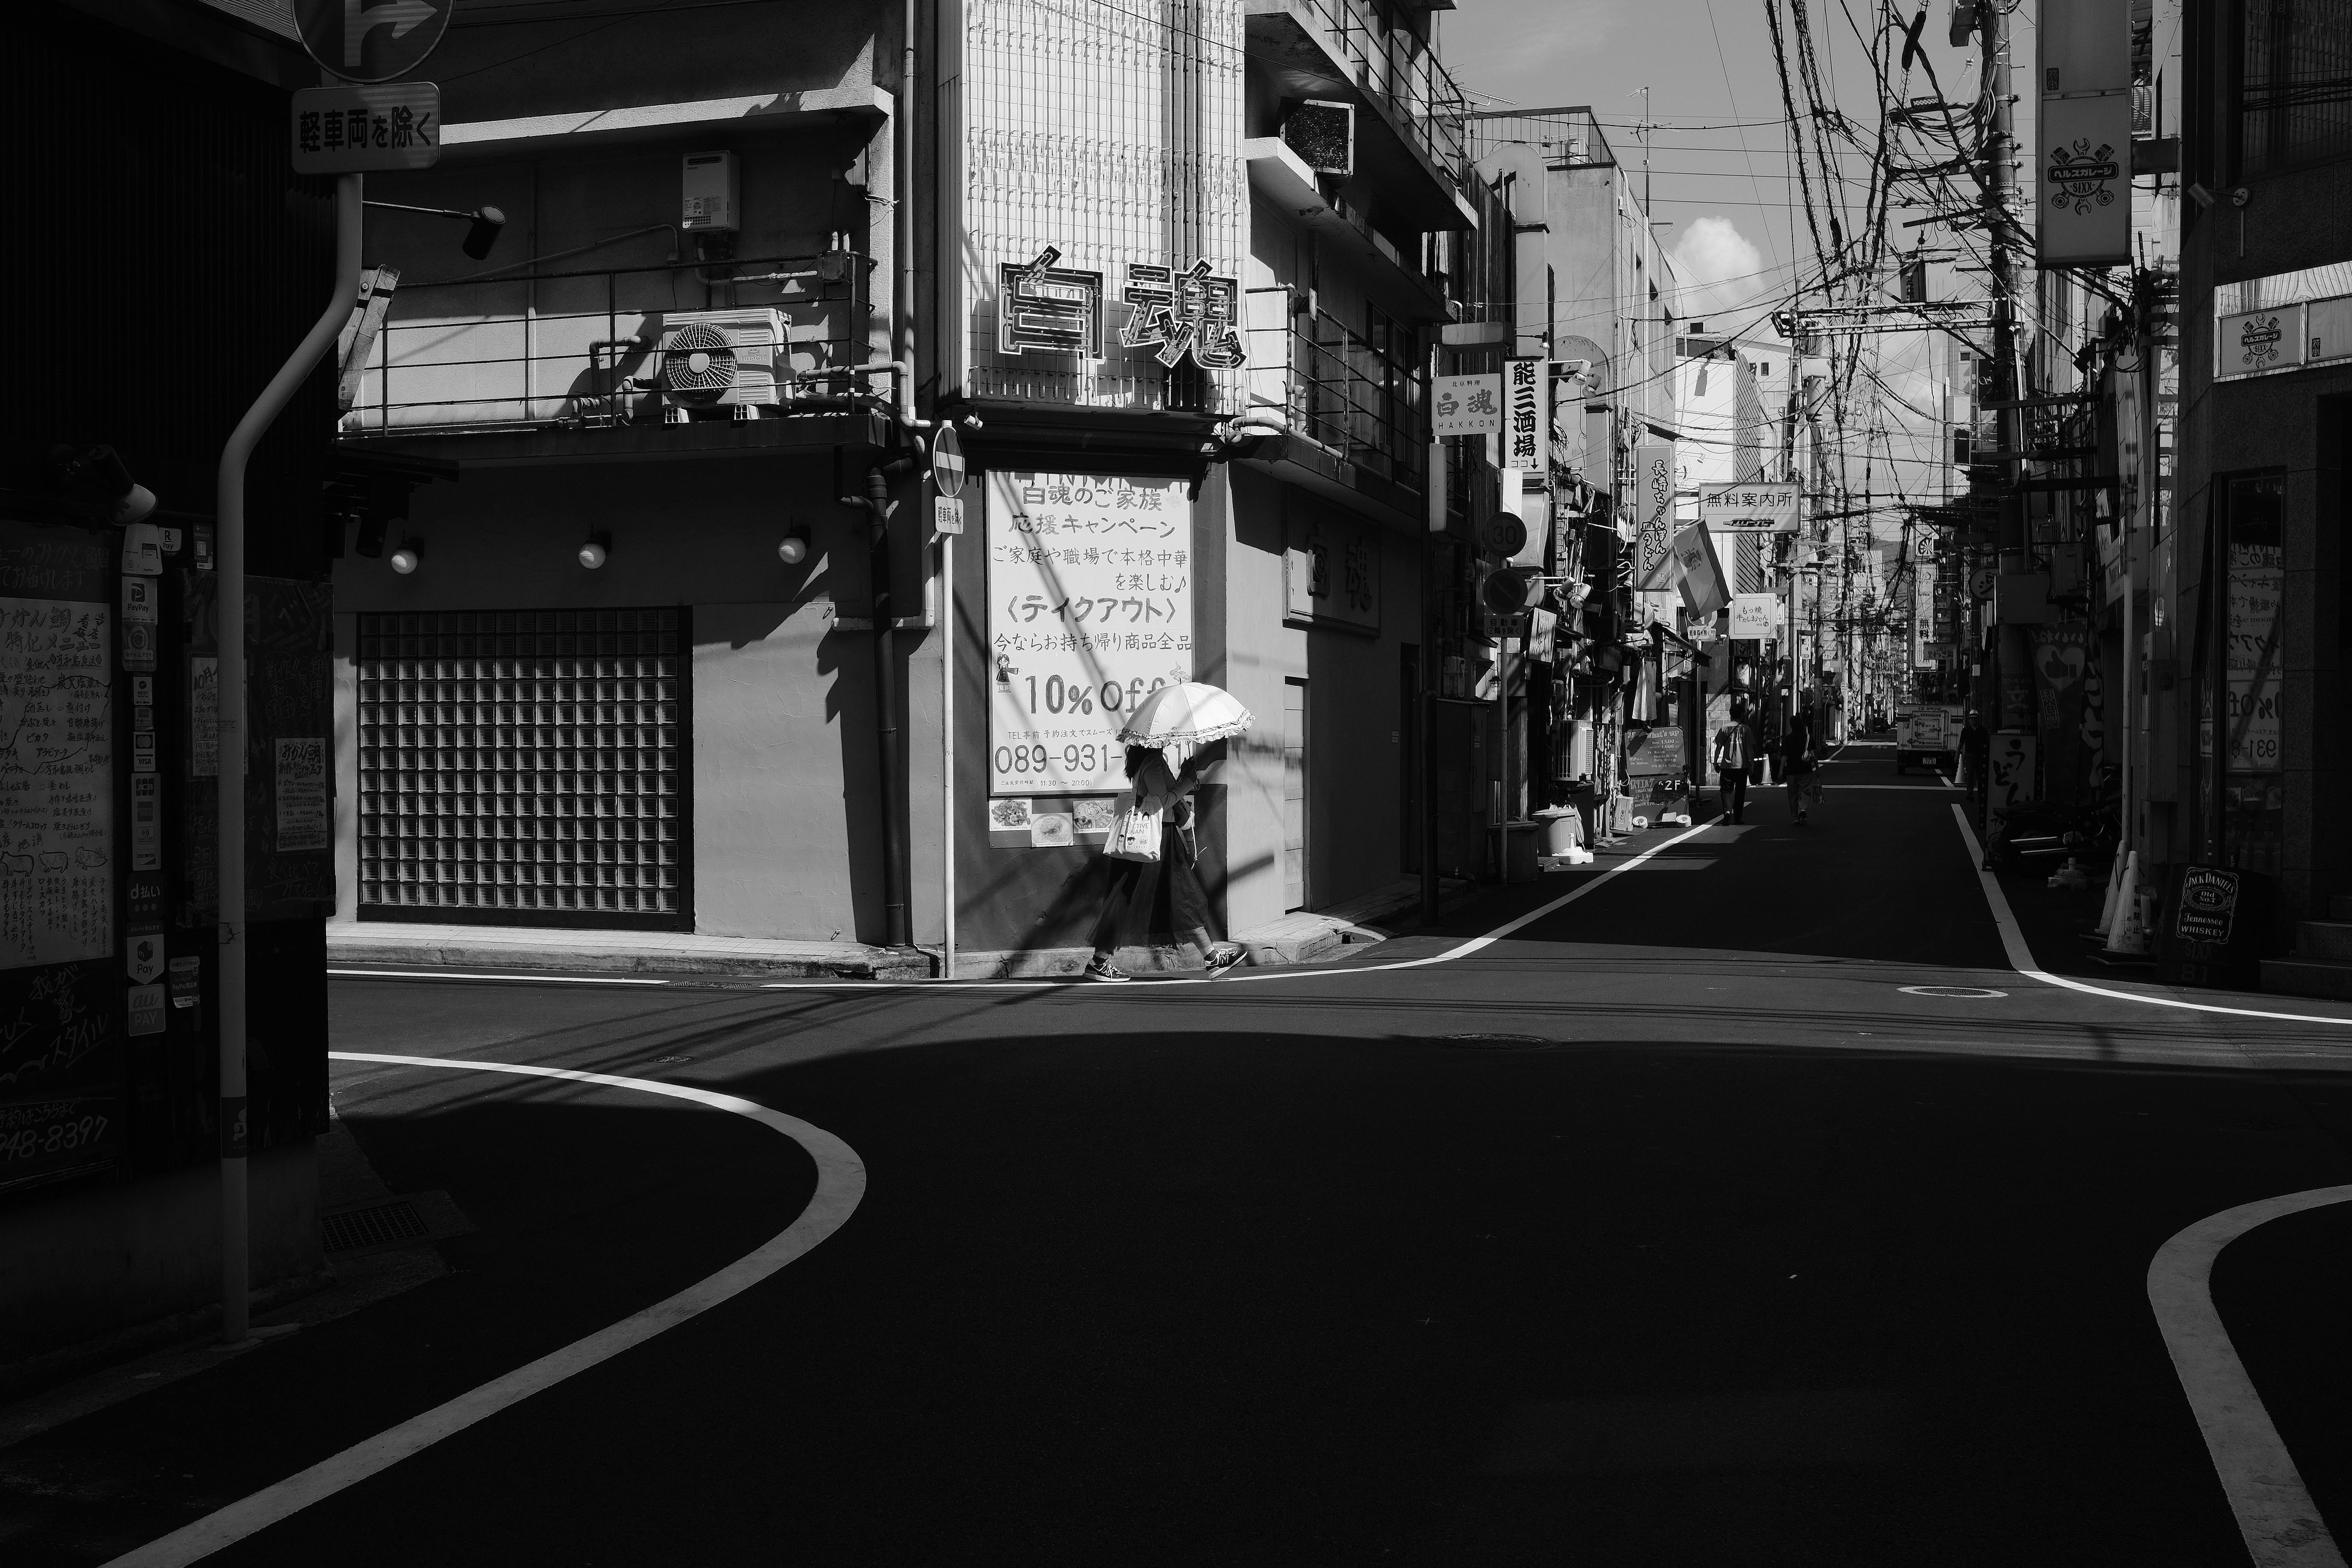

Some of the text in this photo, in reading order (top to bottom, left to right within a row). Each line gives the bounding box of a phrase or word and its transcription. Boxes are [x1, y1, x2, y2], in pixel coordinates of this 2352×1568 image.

[299, 106, 431, 154] 軽車両を除く
[2054, 166, 2112, 178] ヘルズガレージ
[997, 243, 1248, 370] 白魂
[2244, 332, 2278, 343] ヘルズガレージ
[1436, 388, 1498, 417] 白魂
[1513, 362, 1536, 457] 能三酒場
[1438, 419, 1495, 430] HAKKON
[1511, 460, 1529, 468] ココ
[1022, 482, 1163, 511] 白魂のご家族
[1707, 492, 1792, 508] 無料案内所
[1651, 459, 1668, 555] 長崎ちゃんぽん
[938, 506, 962, 525] 軽車両を除く
[1008, 512, 1176, 538] 応援キャンペーン
[1492, 525, 1517, 545] 30
[1640, 520, 1655, 571] 皿うどん
[992, 546, 1188, 569] ご家庭や職場で本格中華
[127, 603, 150, 613] PayPay
[1742, 606, 1763, 614] もつ焼
[1487, 627, 1522, 635] (2輪を除く)
[993, 631, 1192, 652] 今ならお持ち帰り商品全品
[1025, 674, 1093, 715] 10%
[27, 733, 49, 743] ピカタ
[994, 743, 1182, 774] 089-931-1
[48, 779, 71, 791] 釜めし
[1664, 779, 1681, 791] 2F
[2185, 875, 2204, 888] JACK
[130, 883, 160, 900] d払い
[2183, 912, 2224, 926] Tennessee
[2181, 925, 2225, 937] WHISKEY
[137, 964, 154, 976] Pay
[133, 995, 160, 1008] au
[135, 1011, 157, 1027] PAY
